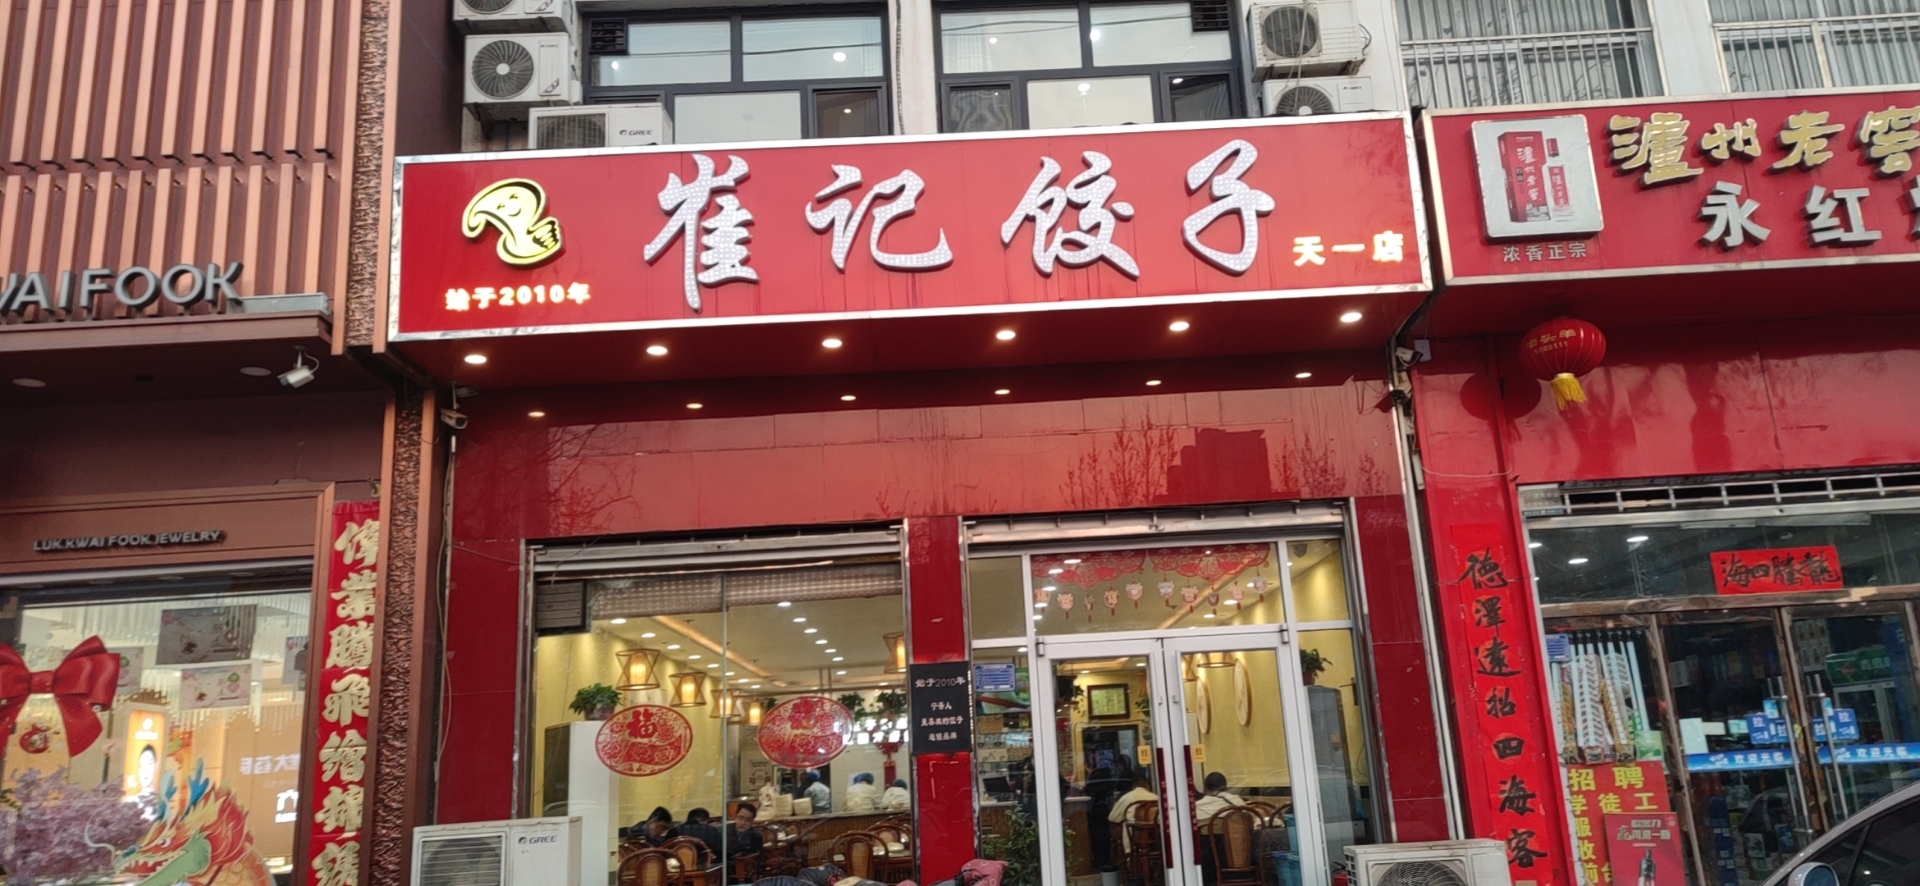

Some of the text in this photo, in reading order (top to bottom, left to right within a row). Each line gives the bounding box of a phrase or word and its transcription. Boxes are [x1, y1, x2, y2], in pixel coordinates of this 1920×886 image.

[642, 138, 1276, 313] 崔记饺子
[1293, 230, 1405, 267] 天一店
[1502, 242, 1587, 262] 浓香正宗
[80, 261, 242, 307] FOOK
[444, 281, 592, 312] 始于2010年
[33, 530, 222, 551] LUK KWAI FOOK JEWELRY
[626, 708, 657, 739] 福
[1734, 751, 1785, 765] 欢迎光临
[1856, 746, 1908, 759] 欢迎光临
[1568, 766, 1645, 792] 招聘
[1571, 792, 1659, 816] 学徒工
[528, 835, 558, 845] GREE
